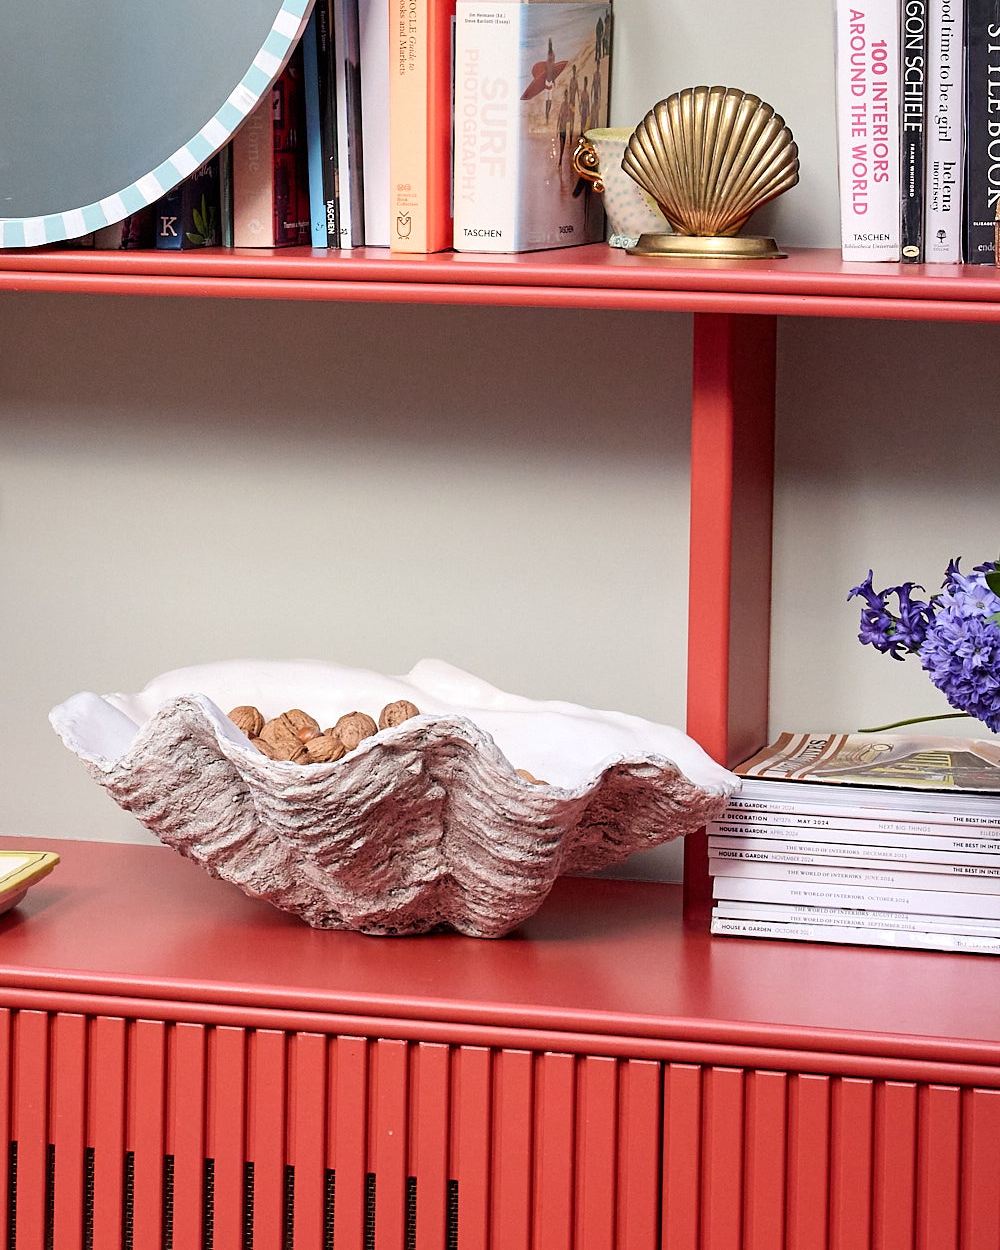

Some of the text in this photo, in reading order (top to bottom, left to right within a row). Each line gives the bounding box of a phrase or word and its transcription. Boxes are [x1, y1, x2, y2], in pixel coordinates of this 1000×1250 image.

[399, 20, 408, 37] and
[409, 36, 417, 61] Guide
[941, 27, 954, 62] time
[399, 40, 408, 75] Markets
[409, 63, 417, 71] to
[940, 63, 953, 80] to
[904, 56, 923, 131] SCHIELE
[939, 83, 954, 102] be
[849, 9, 869, 215] AROUND THE WORLD
[872, 39, 889, 183] 100 INTERIORS
[939, 104, 949, 112] a
[935, 116, 952, 142] girl
[930, 160, 943, 213] morrissey
[942, 161, 956, 213] helena
[327, 199, 335, 235] TASCHEN
[463, 229, 501, 238] TASCHEN
[853, 233, 890, 241] TASCHEN
[727, 813, 768, 822] DECORATION
